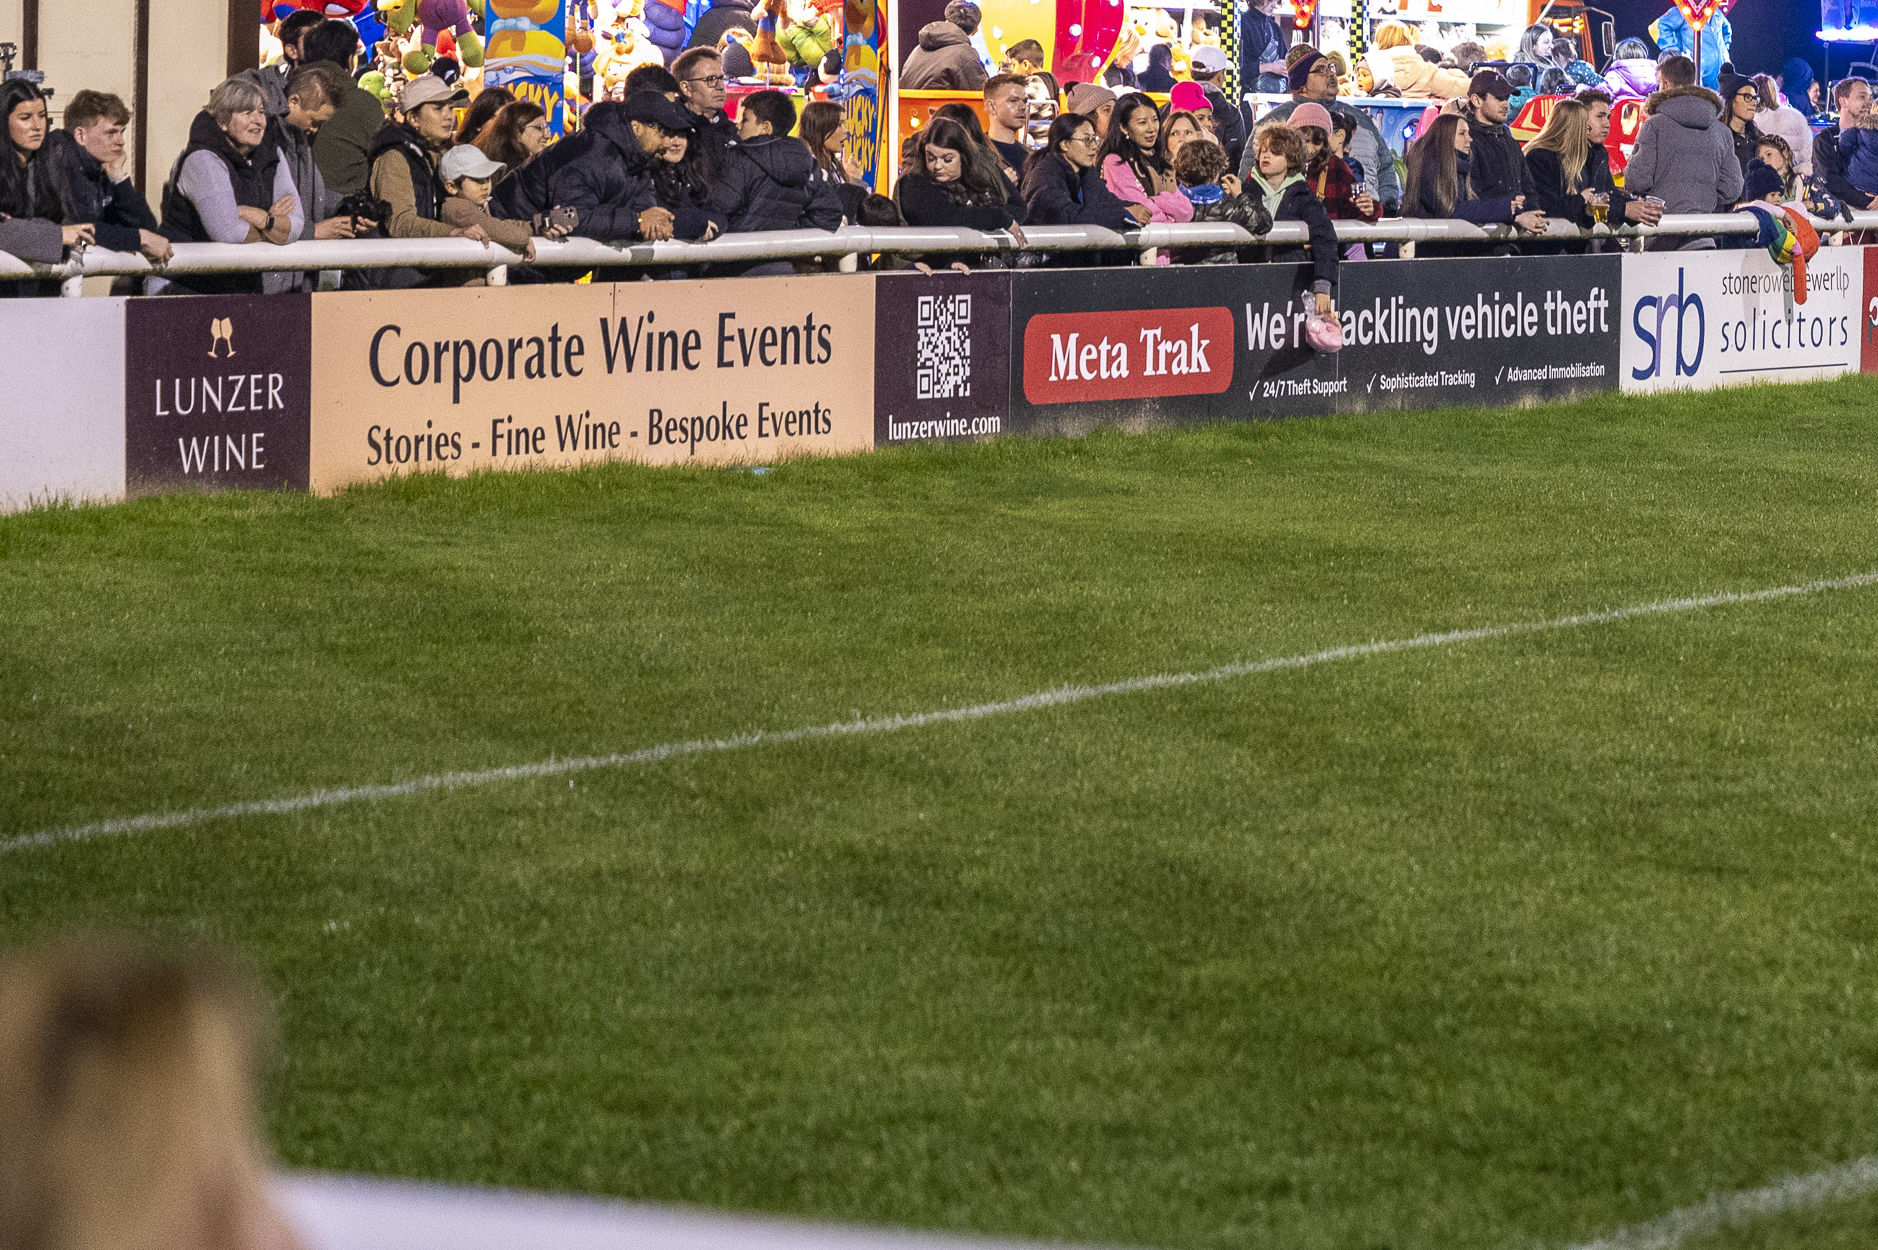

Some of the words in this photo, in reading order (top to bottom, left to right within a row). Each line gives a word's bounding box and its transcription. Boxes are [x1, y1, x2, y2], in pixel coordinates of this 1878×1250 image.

[1246, 300, 1305, 351] We'r
[1331, 295, 1439, 355] ackling
[1445, 291, 1540, 342] vehicle
[1544, 287, 1609, 337] theft
[1631, 267, 1706, 381] srb
[1720, 306, 1849, 353] solicitors
[368, 322, 585, 404] Corporate
[600, 310, 702, 375] Wine
[716, 311, 833, 369] Events
[1048, 332, 1129, 382] Meta
[1139, 322, 1211, 377] Trak
[1507, 366, 1548, 383] Advanced
[1549, 362, 1605, 380] Immobilisation
[155, 373, 285, 417] LUNZER
[1263, 380, 1286, 399] 24/7
[1287, 378, 1312, 395] Theft
[1312, 377, 1348, 397] Support
[1380, 369, 1439, 393] Sophisticated
[1440, 369, 1476, 389] Tracking
[366, 419, 463, 466] Stories
[491, 414, 546, 457] Fine
[555, 410, 621, 452] Wine
[648, 400, 748, 456] Bespoke
[758, 401, 833, 439] Events
[888, 411, 1001, 441] lunzerwine.com
[178, 432, 265, 474] WINE
